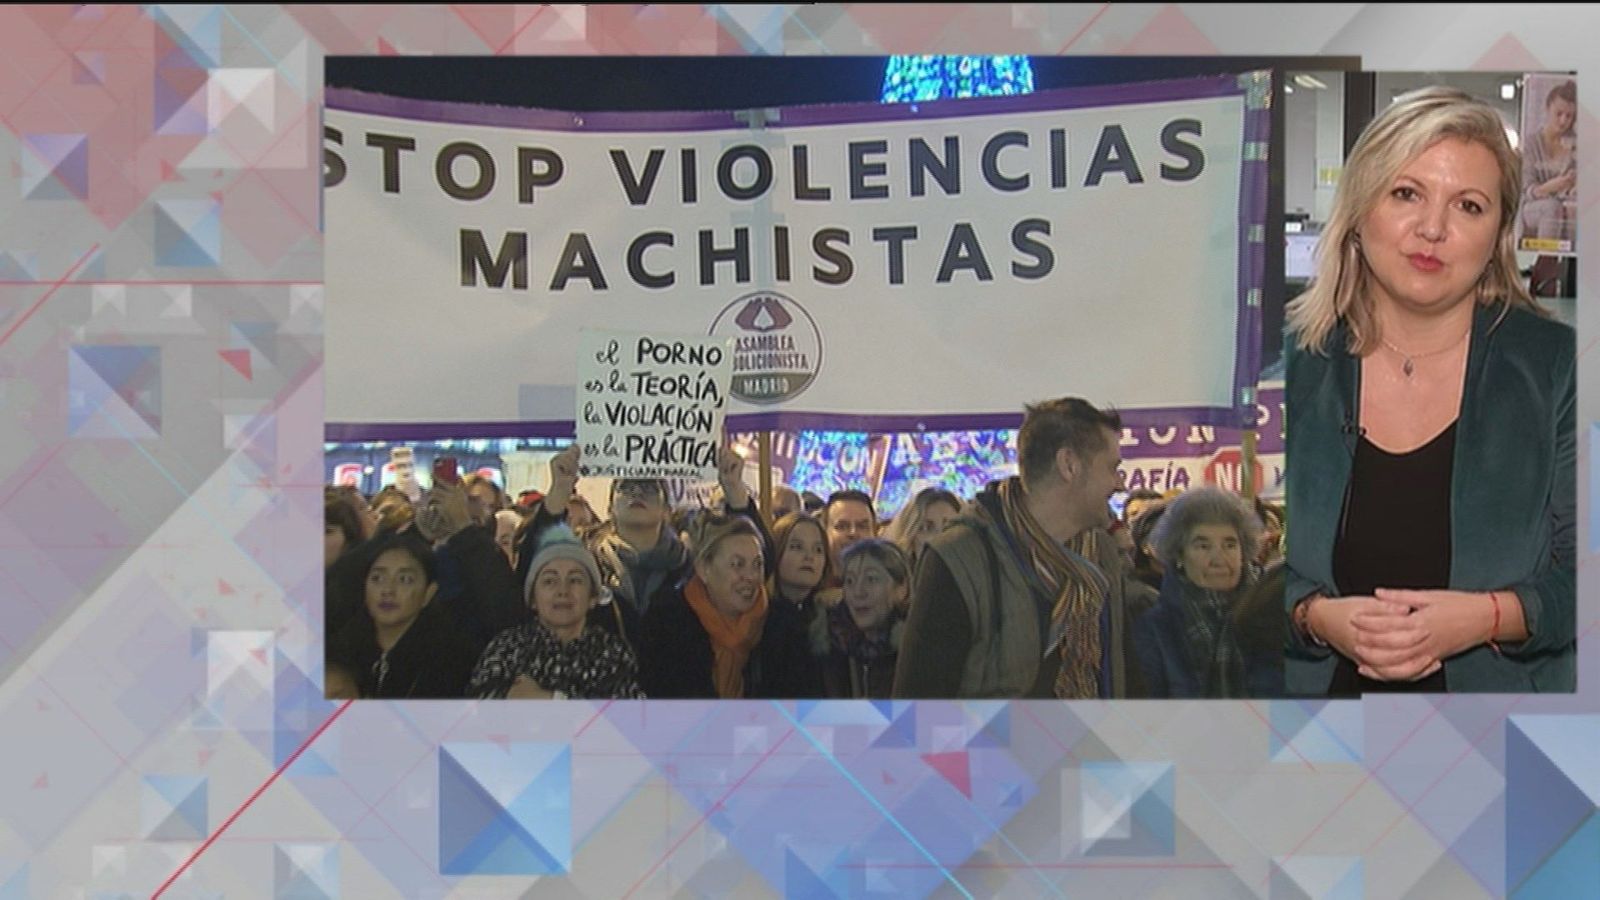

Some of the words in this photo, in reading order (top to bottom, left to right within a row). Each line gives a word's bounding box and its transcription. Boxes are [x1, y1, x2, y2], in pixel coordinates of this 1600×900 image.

[609, 118, 1206, 206] VIOLENCIAS
[459, 218, 1056, 291] MACHISTAS
[596, 340, 619, 365] el
[637, 336, 722, 366] PORNO
[735, 335, 796, 353] ASAMBLEA
[585, 379, 603, 394] es
[608, 369, 627, 393] la
[631, 371, 724, 408] TEORÍA,
[743, 377, 790, 395] MADRID
[584, 402, 602, 424] la
[605, 403, 713, 434] VIOLACIÓN
[584, 442, 599, 457] es
[602, 433, 620, 457] la
[625, 429, 718, 469] PRÁCTICA
